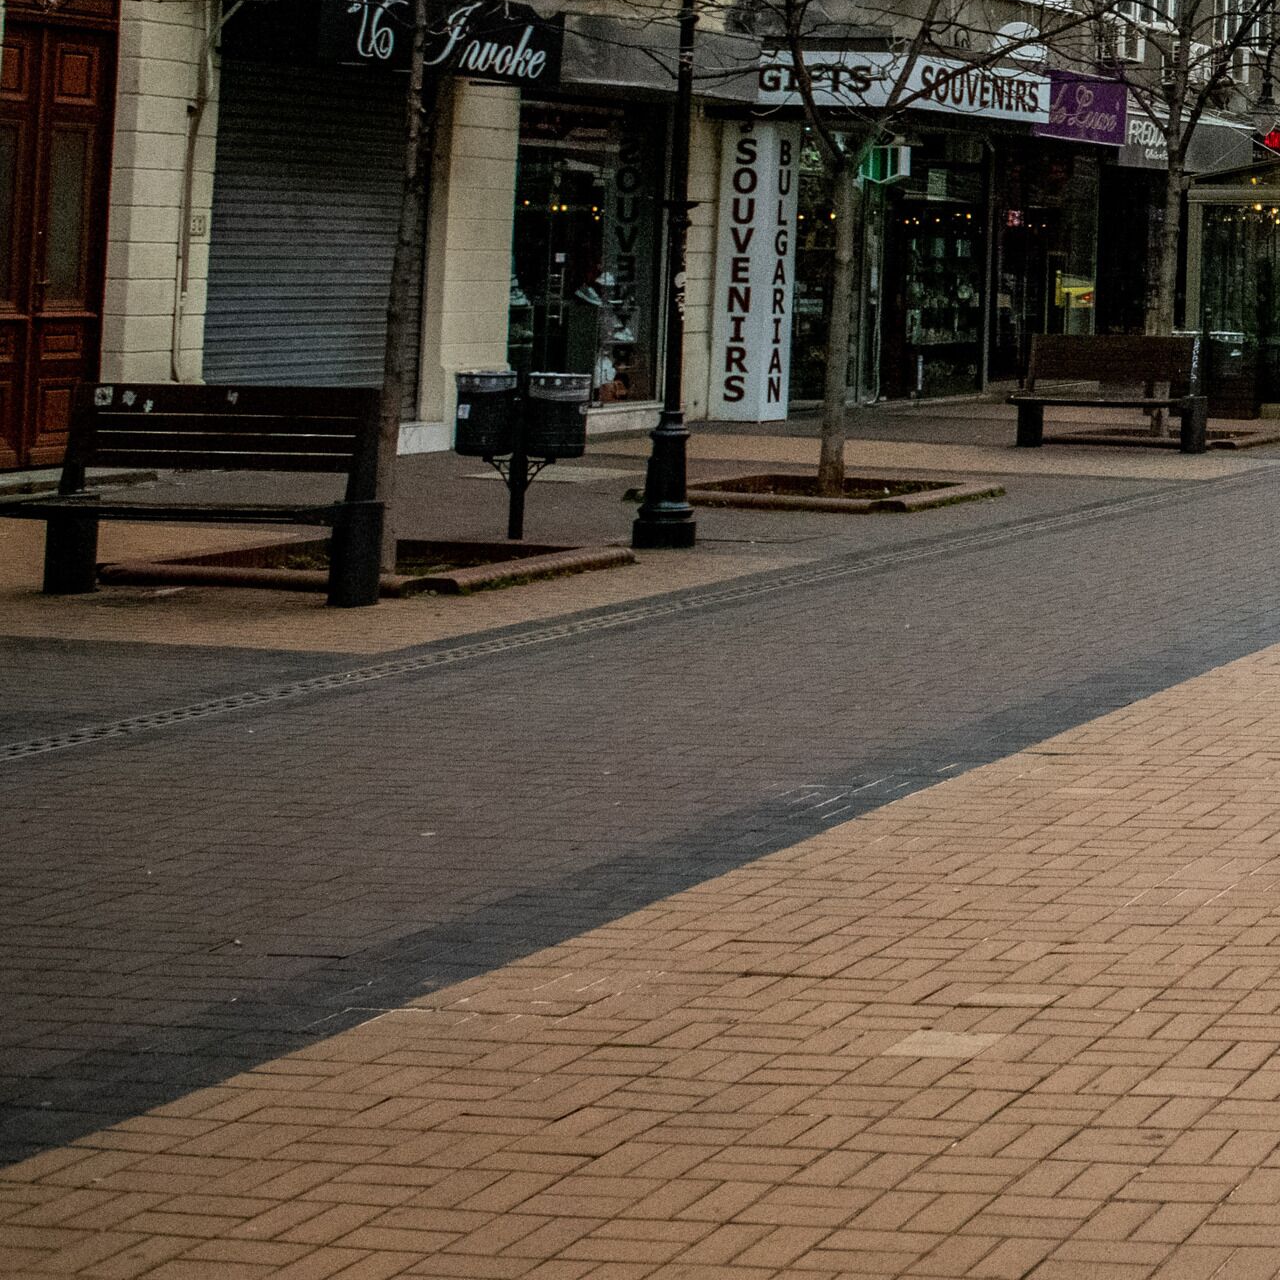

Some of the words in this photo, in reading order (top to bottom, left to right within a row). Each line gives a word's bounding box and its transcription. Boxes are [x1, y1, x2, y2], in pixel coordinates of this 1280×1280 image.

[921, 64, 1039, 113] SOUVENIRS
[722, 138, 758, 403] SOUVENIRS
[767, 140, 792, 403] BULGARIAN
